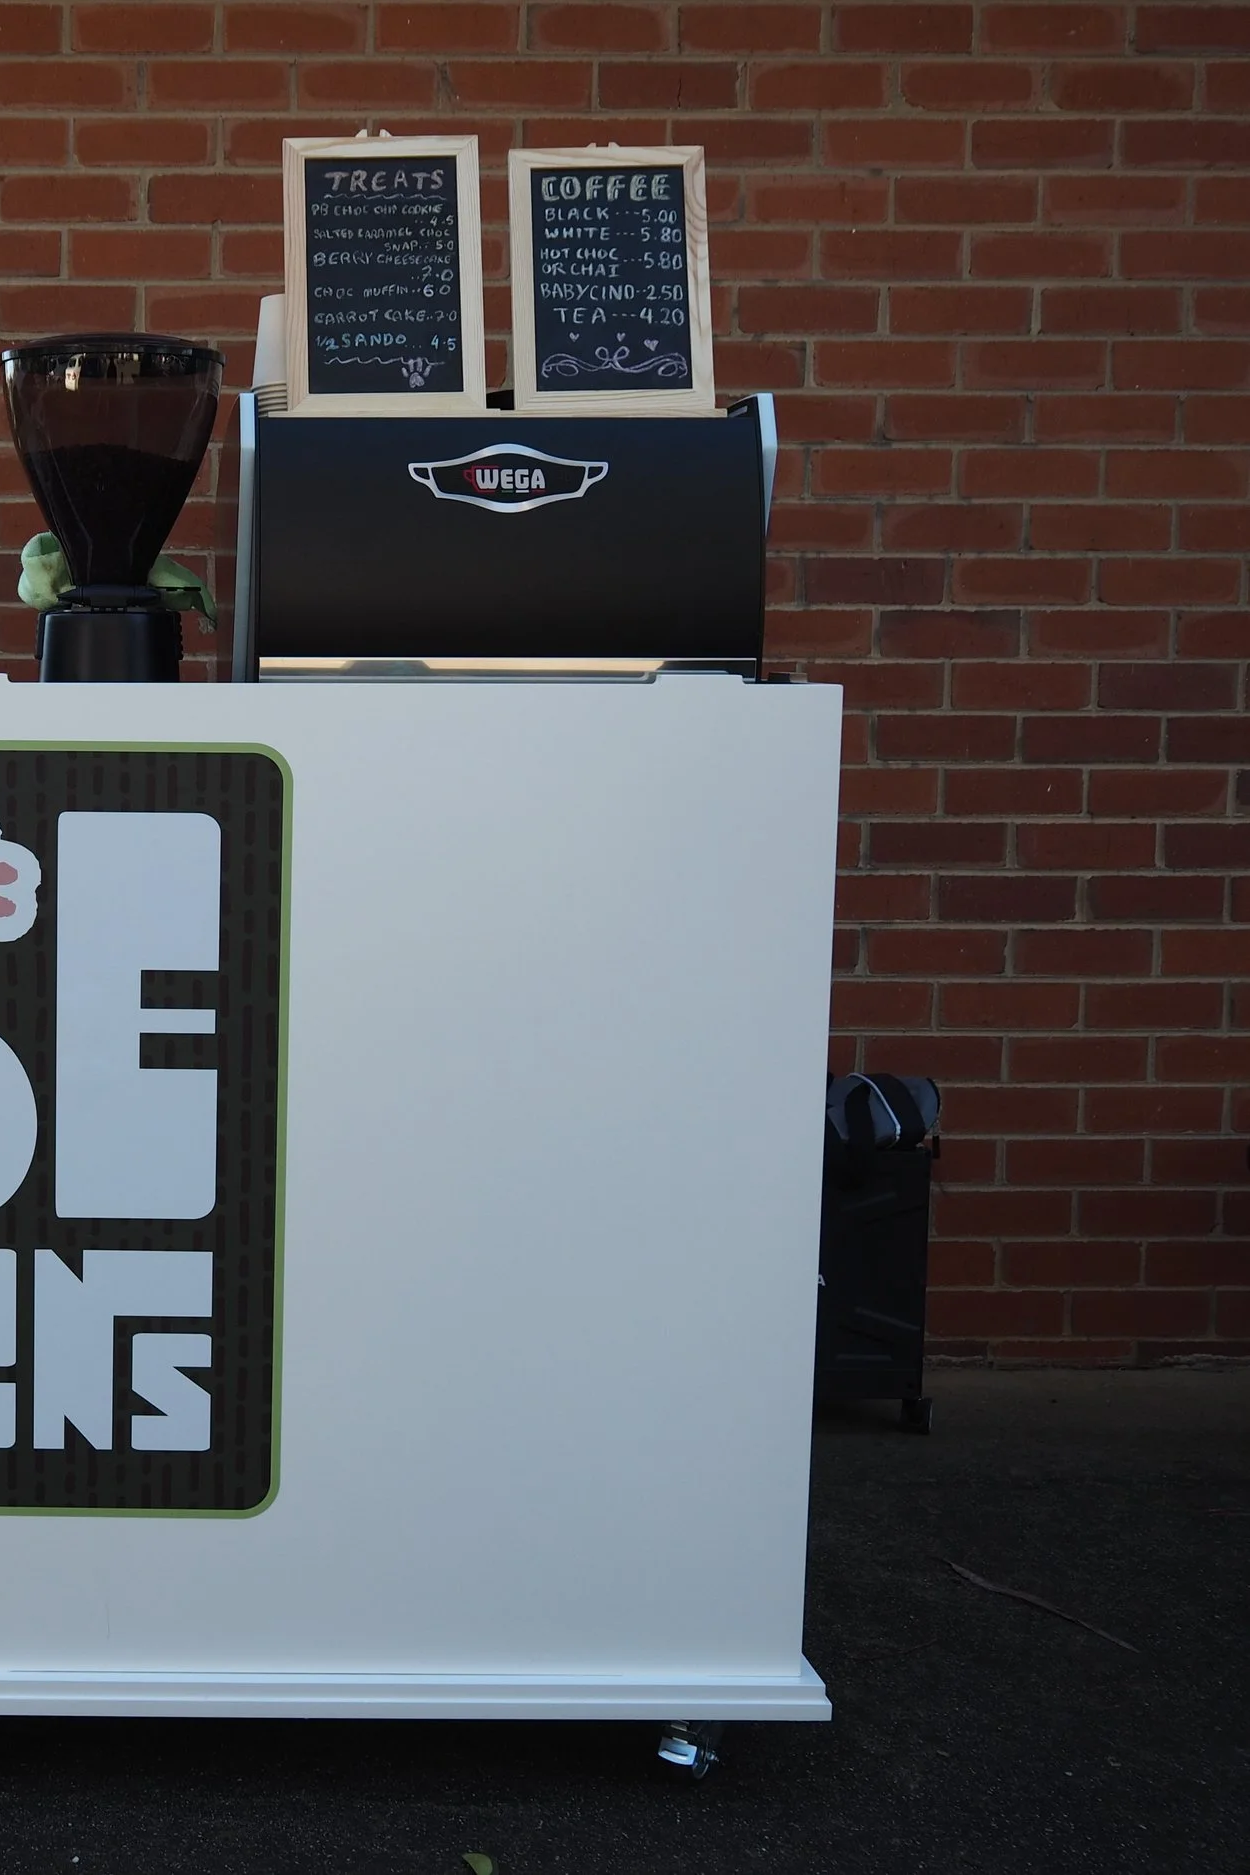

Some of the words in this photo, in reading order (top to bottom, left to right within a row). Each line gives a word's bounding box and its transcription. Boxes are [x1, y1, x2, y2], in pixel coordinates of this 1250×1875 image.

[324, 169, 444, 192] TREATS
[541, 174, 671, 201] COFFEE
[311, 203, 329, 216] PB
[334, 204, 369, 216] CHOC
[401, 203, 444, 215] COOKIE
[545, 207, 610, 222] BLACK
[313, 228, 354, 239] SALTED
[357, 226, 413, 239] CARAMEL
[419, 228, 451, 238] CHOC
[544, 227, 611, 241] WHITE
[313, 250, 373, 267] BERRY
[540, 248, 570, 260] HOT
[576, 248, 619, 260] CHOC
[542, 262, 566, 276] OR
[570, 262, 621, 278] CHAI
[314, 286, 354, 300] CHOC
[363, 284, 409, 298] MUFFIN
[540, 283, 635, 301] BABYCINO
[313, 309, 379, 326] CARROT
[384, 309, 426, 323] CAKE
[553, 307, 607, 325] TEA
[342, 333, 407, 348] SANDO
[475, 468, 546, 490] WEGA
